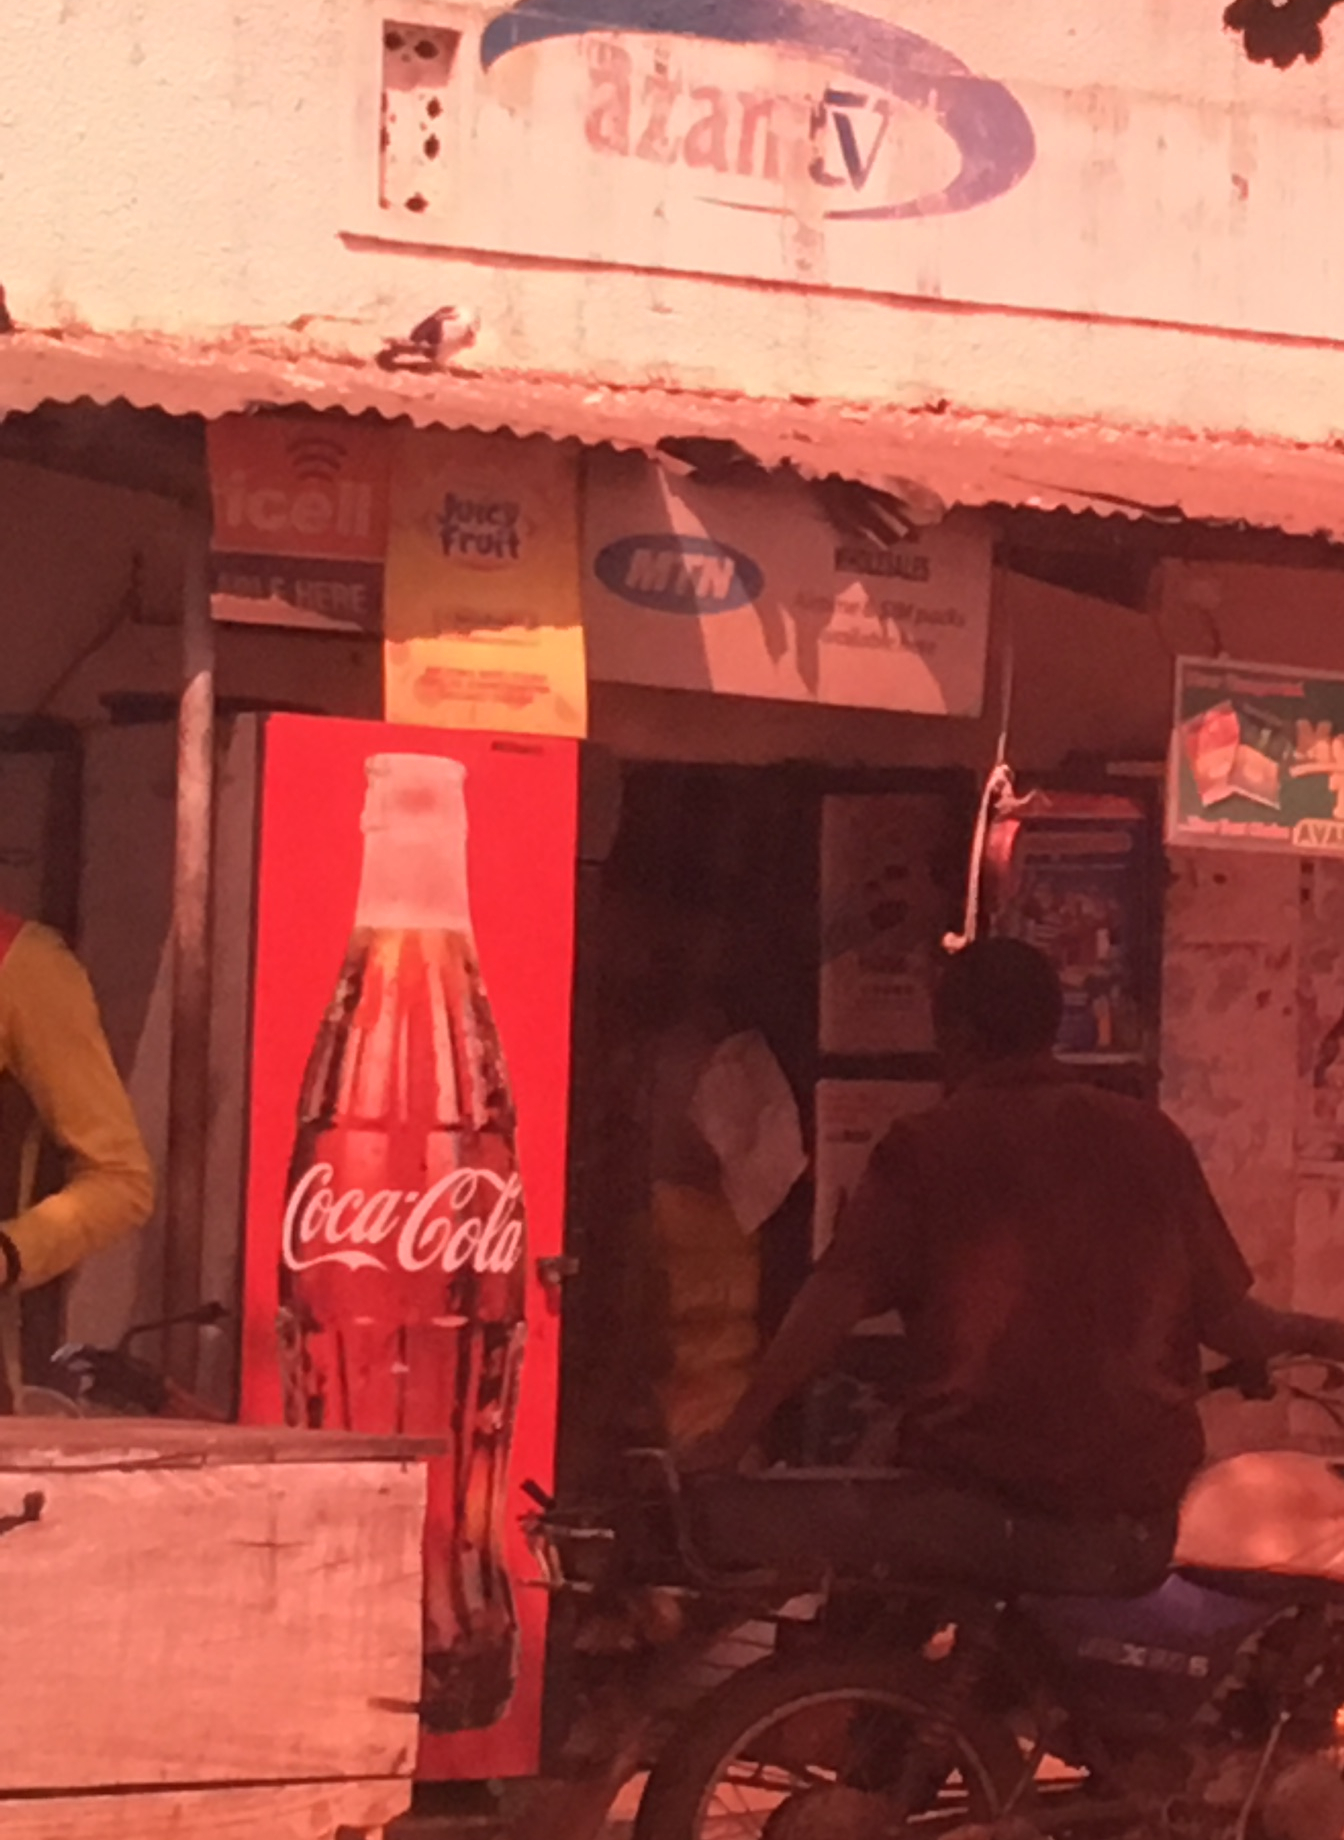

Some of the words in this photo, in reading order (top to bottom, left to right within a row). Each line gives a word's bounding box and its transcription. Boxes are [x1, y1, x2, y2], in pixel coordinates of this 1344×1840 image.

[213, 469, 372, 538] icell
[435, 491, 521, 528] Juicy
[440, 524, 521, 559] Fruit
[624, 548, 736, 600] MTN
[282, 1162, 523, 1276] Coca-Cola
